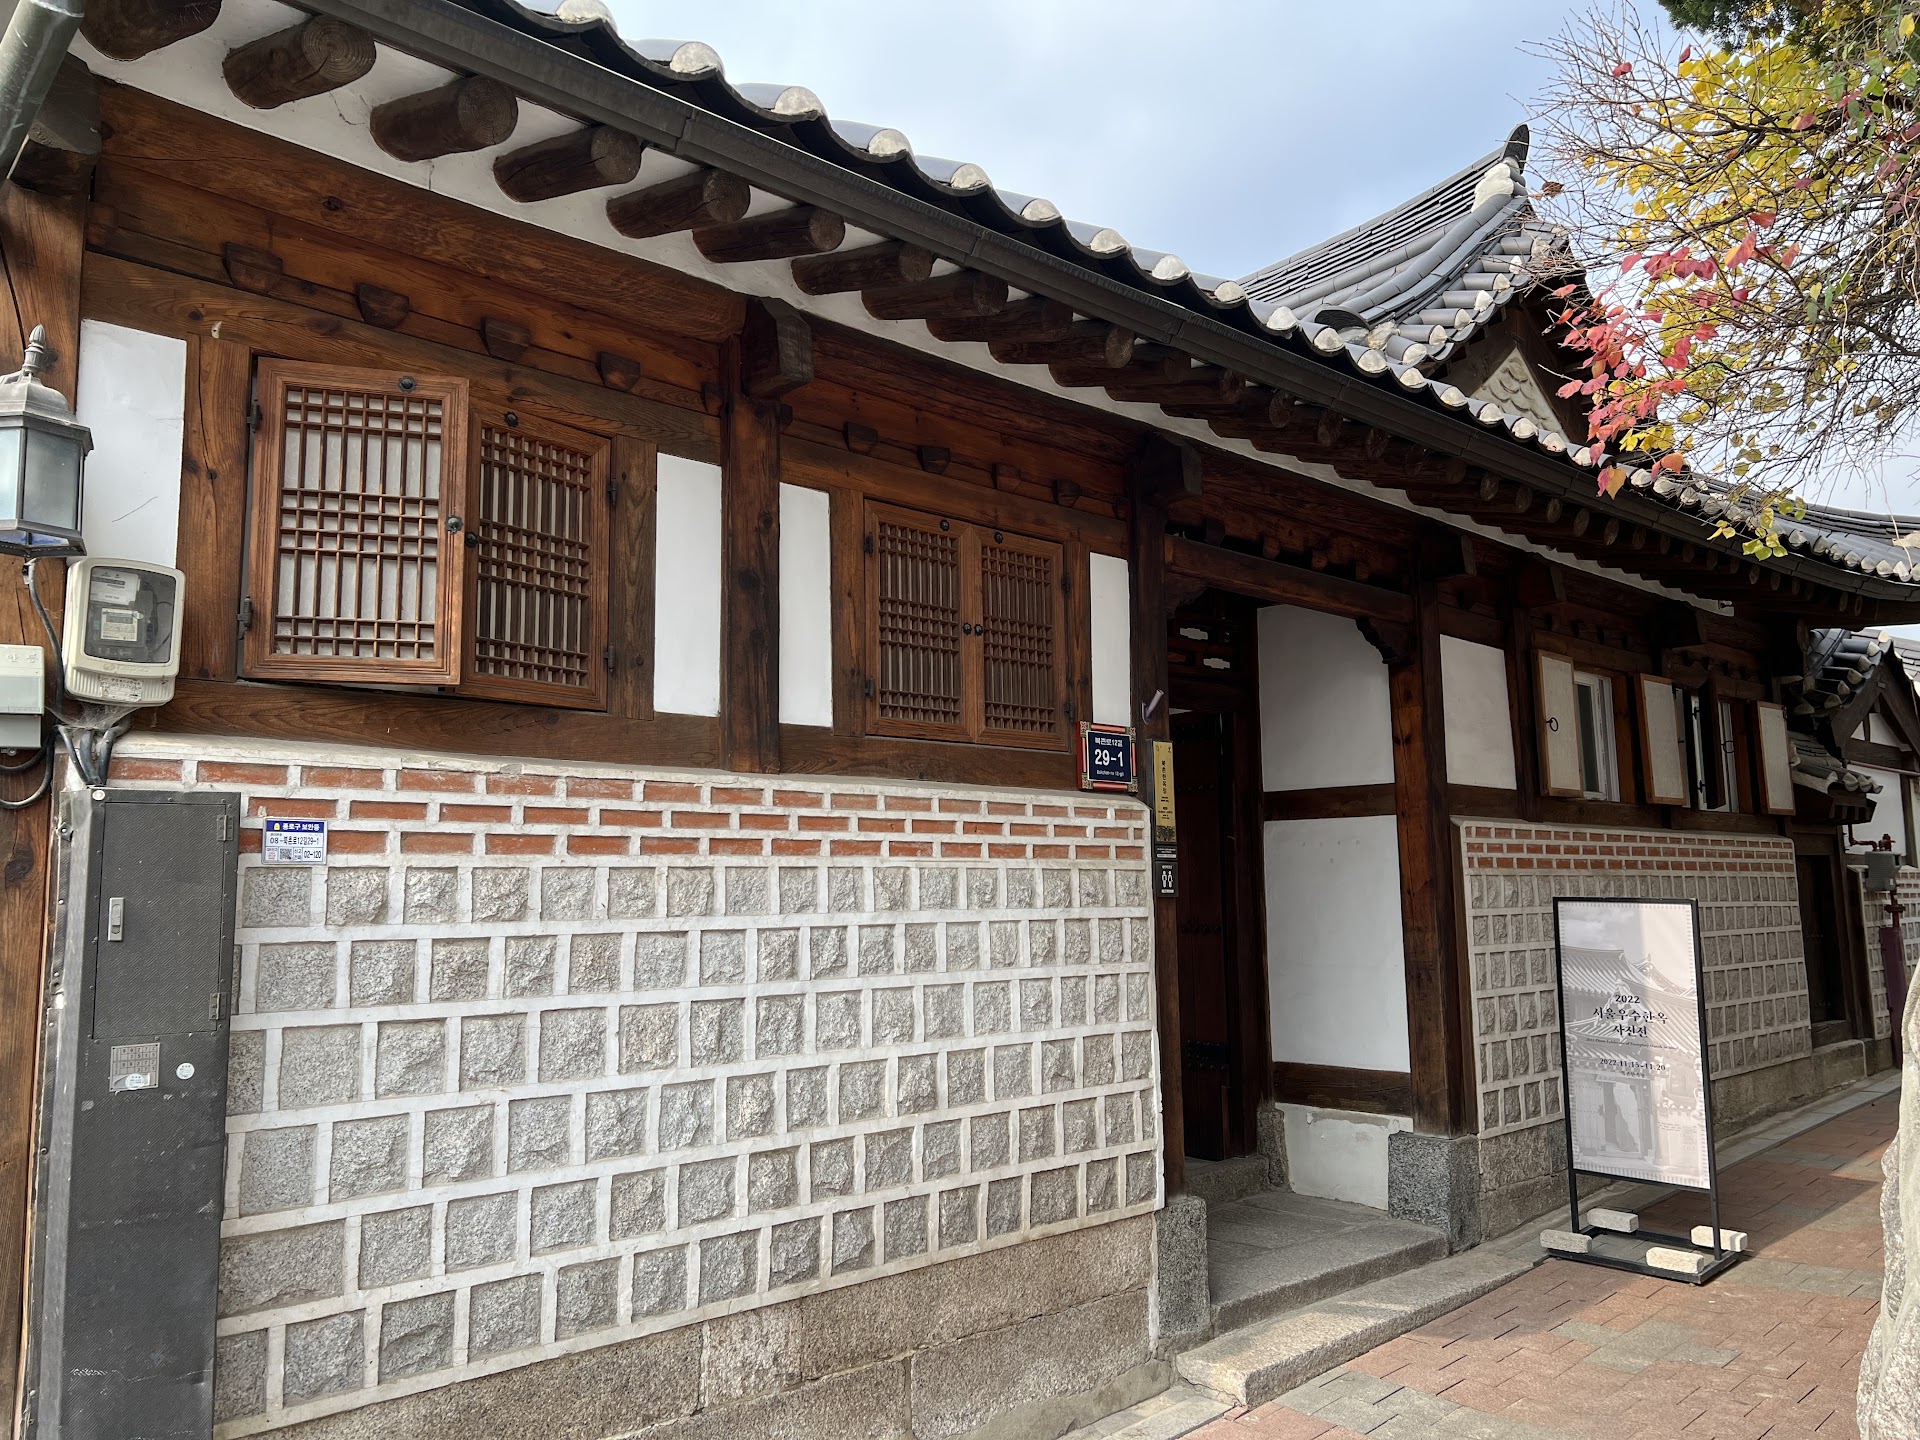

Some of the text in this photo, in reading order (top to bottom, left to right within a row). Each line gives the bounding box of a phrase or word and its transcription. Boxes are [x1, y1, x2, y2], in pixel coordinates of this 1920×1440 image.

[1094, 748, 1123, 767] 29-1
[1614, 994, 1640, 1004] 2022
[1593, 1007, 1668, 1025] 서울우수한옥
[1612, 1024, 1648, 1038] 사진전
